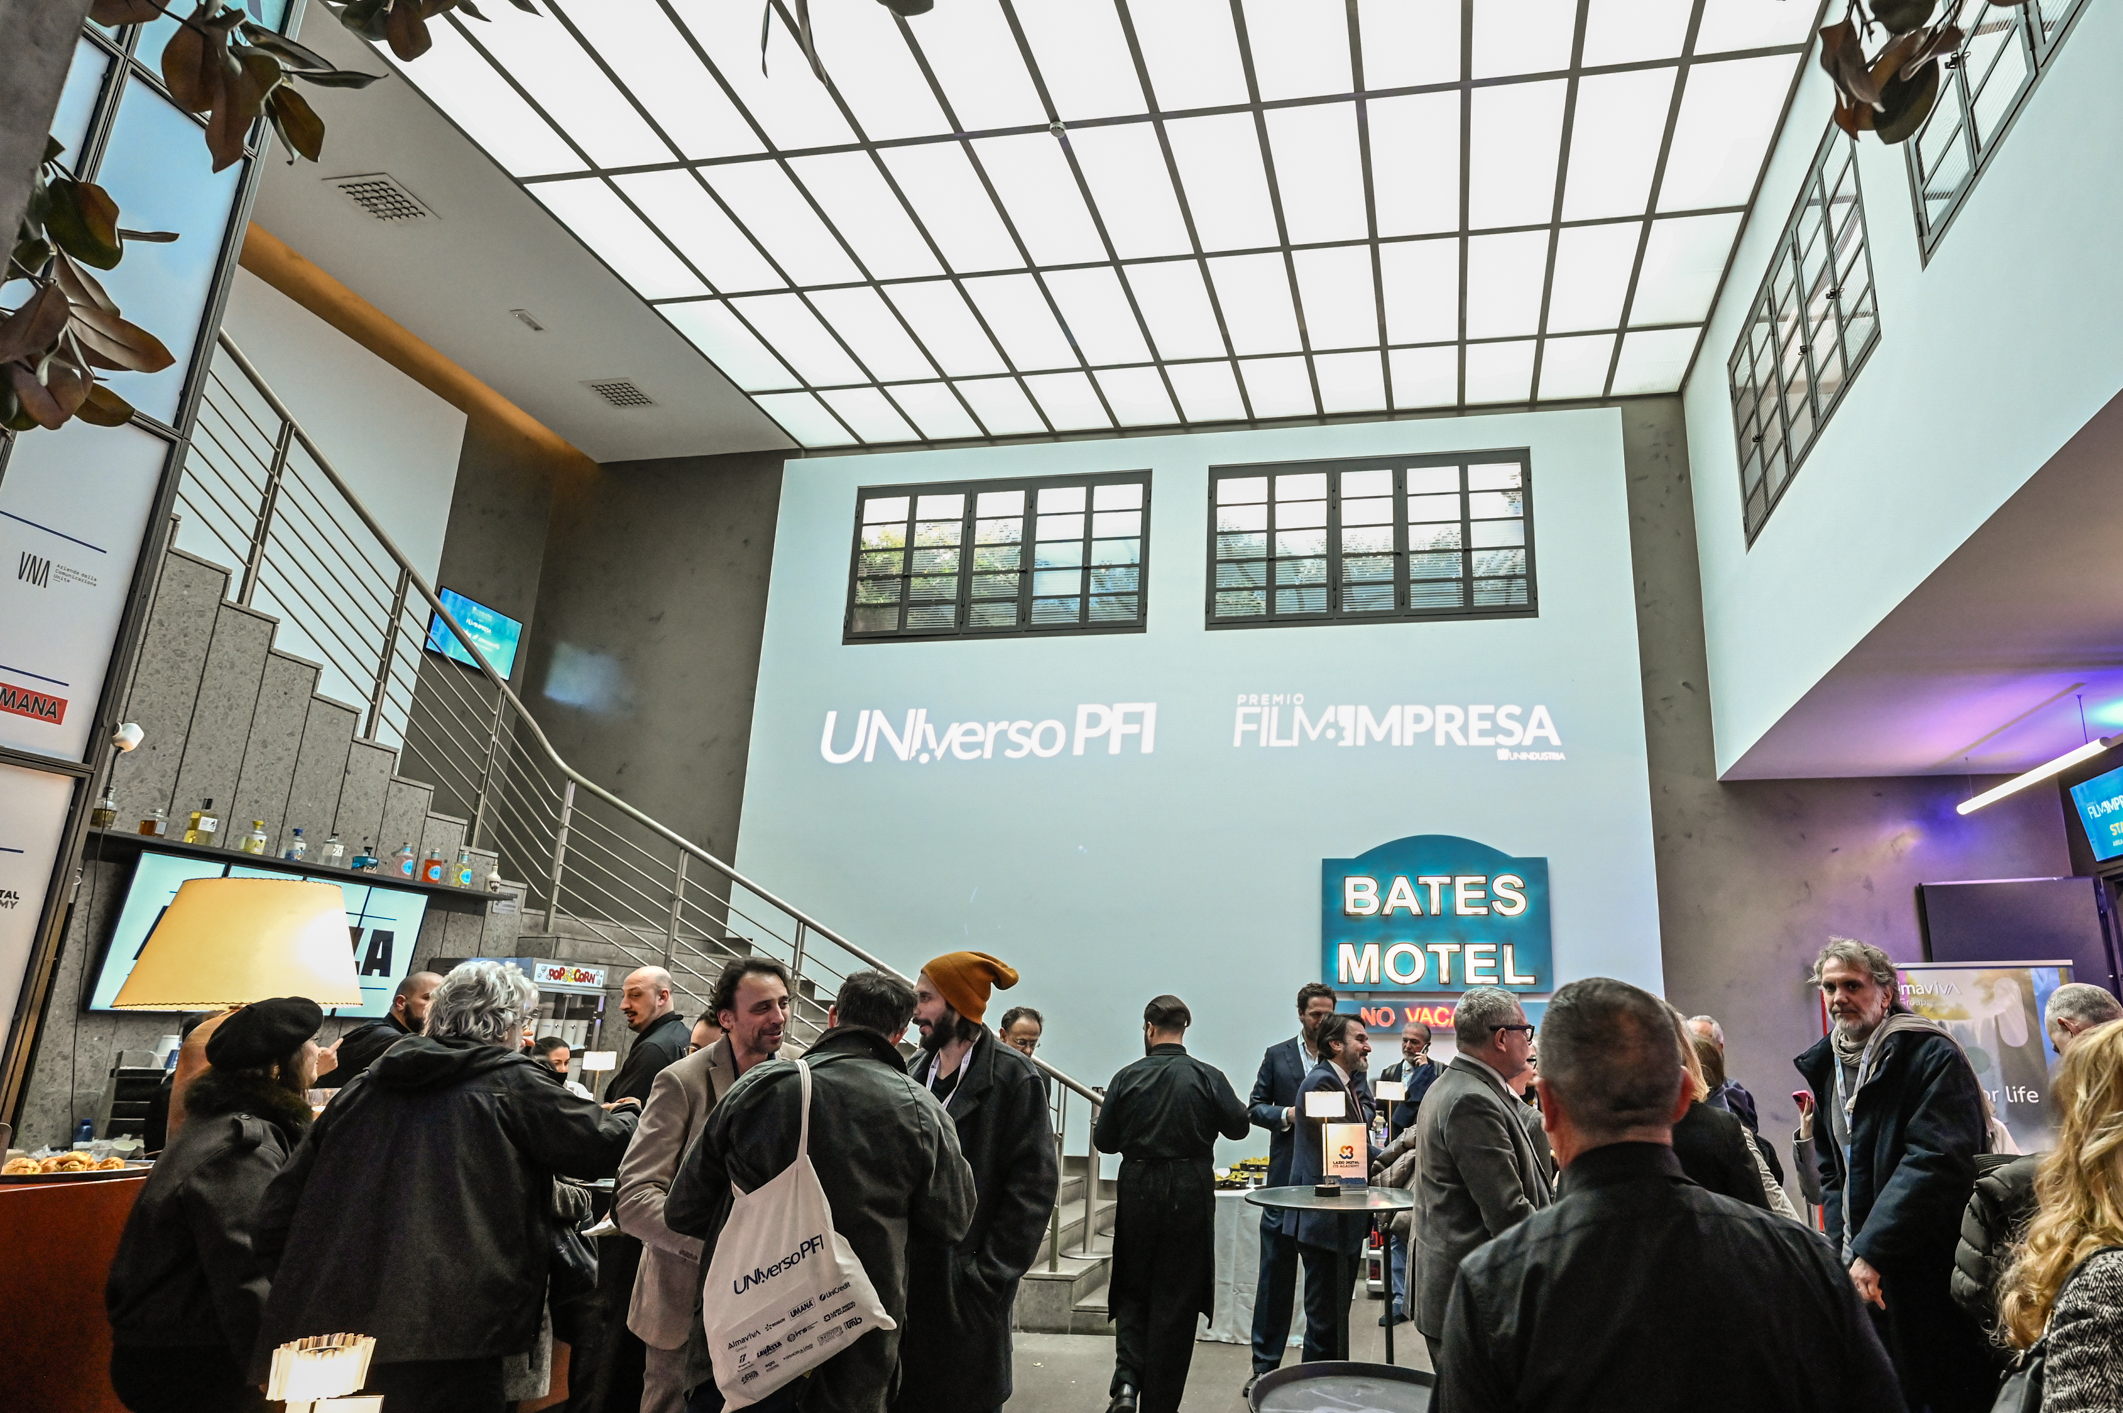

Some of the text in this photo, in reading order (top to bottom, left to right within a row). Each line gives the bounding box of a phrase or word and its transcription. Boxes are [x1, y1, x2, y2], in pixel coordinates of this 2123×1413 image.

[1237, 693, 1305, 705] PREMIO
[1072, 702, 1157, 756] PFI
[1344, 873, 1528, 917] BATES
[548, 967, 565, 980] POP
[1338, 942, 1537, 985] MOTEL
[1360, 1007, 1396, 1027] NO
[2005, 1085, 2039, 1103] life
[800, 1234, 824, 1259] PFI
